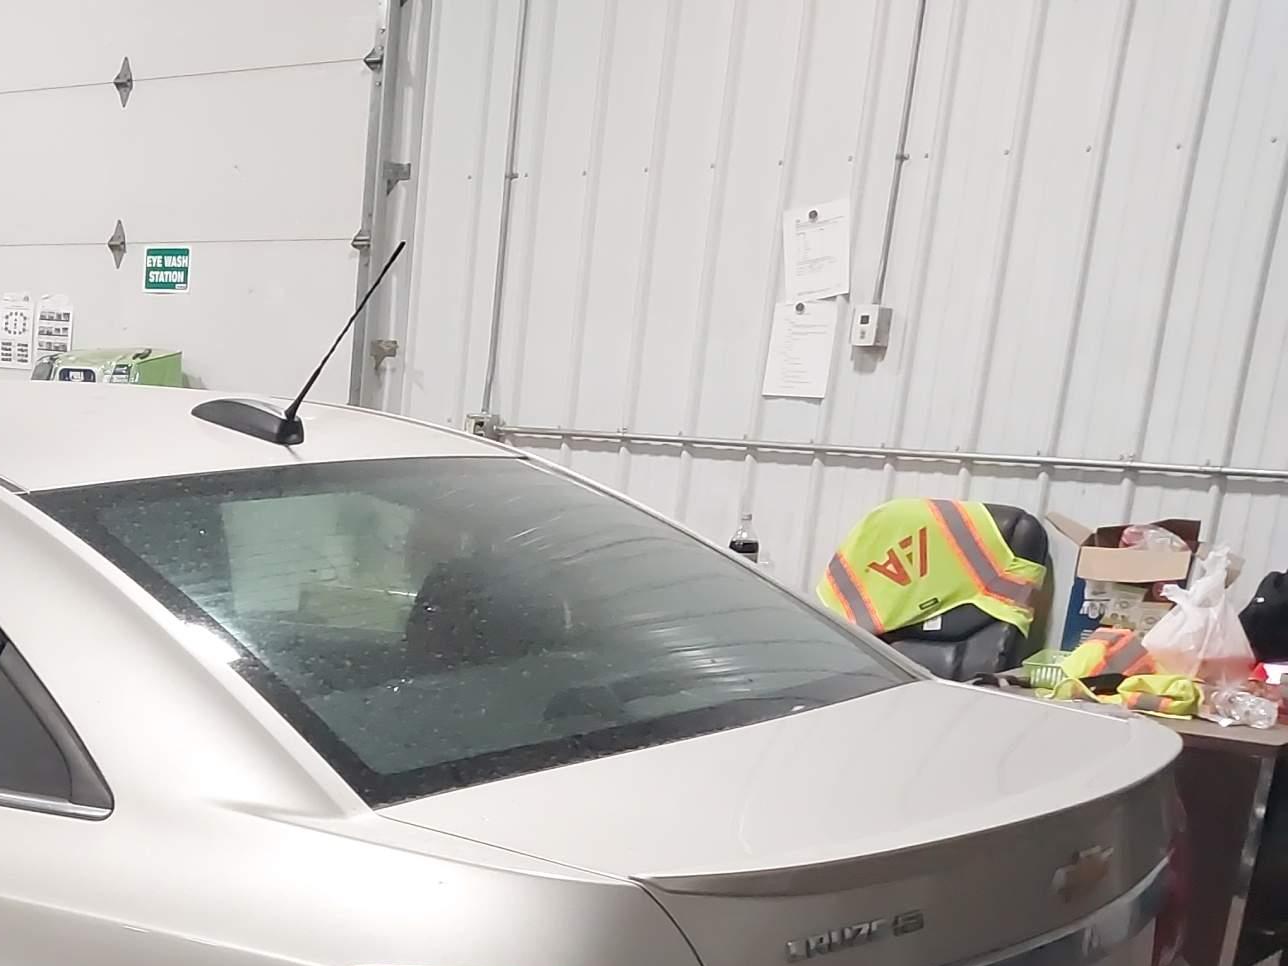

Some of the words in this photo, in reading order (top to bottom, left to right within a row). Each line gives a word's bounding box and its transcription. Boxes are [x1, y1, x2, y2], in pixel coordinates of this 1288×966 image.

[147, 255, 162, 267] EYE
[164, 255, 188, 267] WASH
[149, 270, 184, 282] STATION
